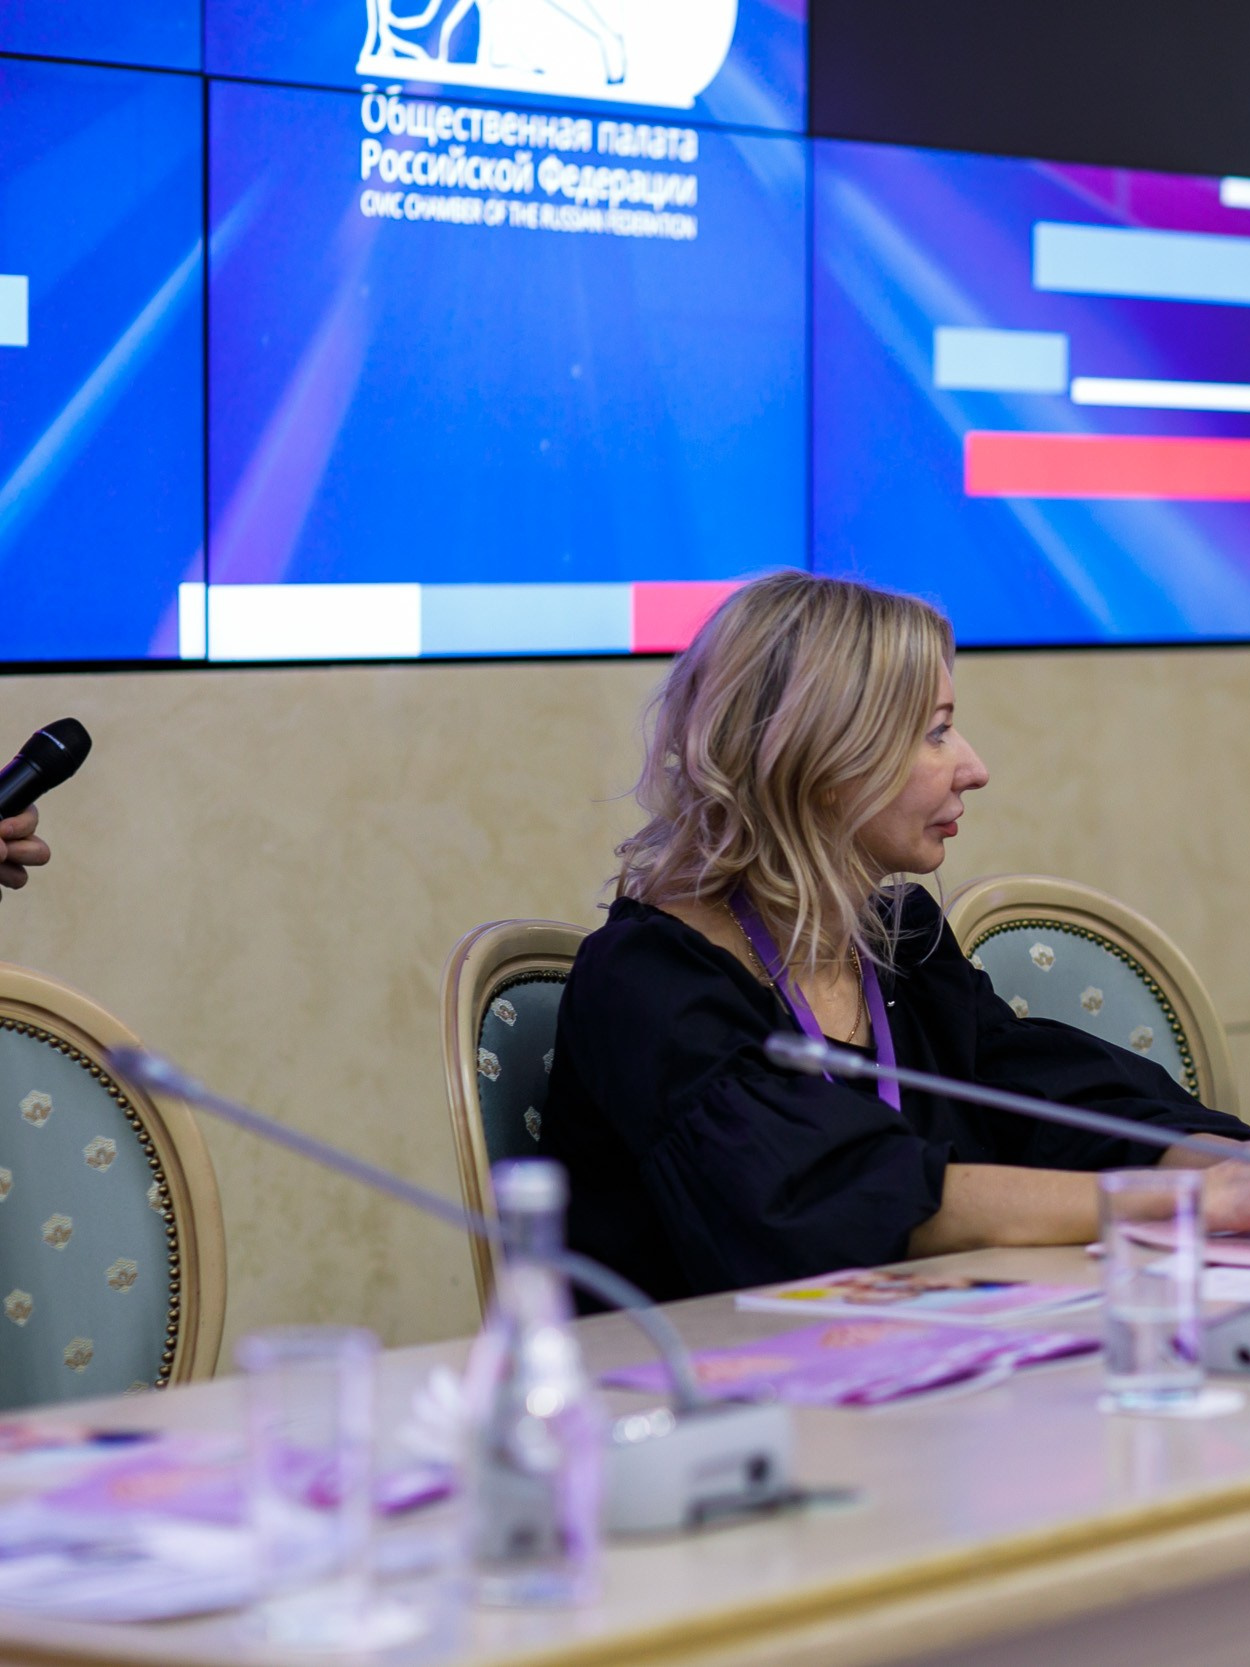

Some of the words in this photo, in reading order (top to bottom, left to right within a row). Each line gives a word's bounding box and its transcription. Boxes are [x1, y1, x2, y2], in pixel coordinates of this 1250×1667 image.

[361, 84, 592, 153] Общественная
[598, 120, 698, 163] палата
[360, 189, 404, 219] CIVIC
[361, 138, 534, 194] Российской
[538, 154, 698, 211] Федерации
